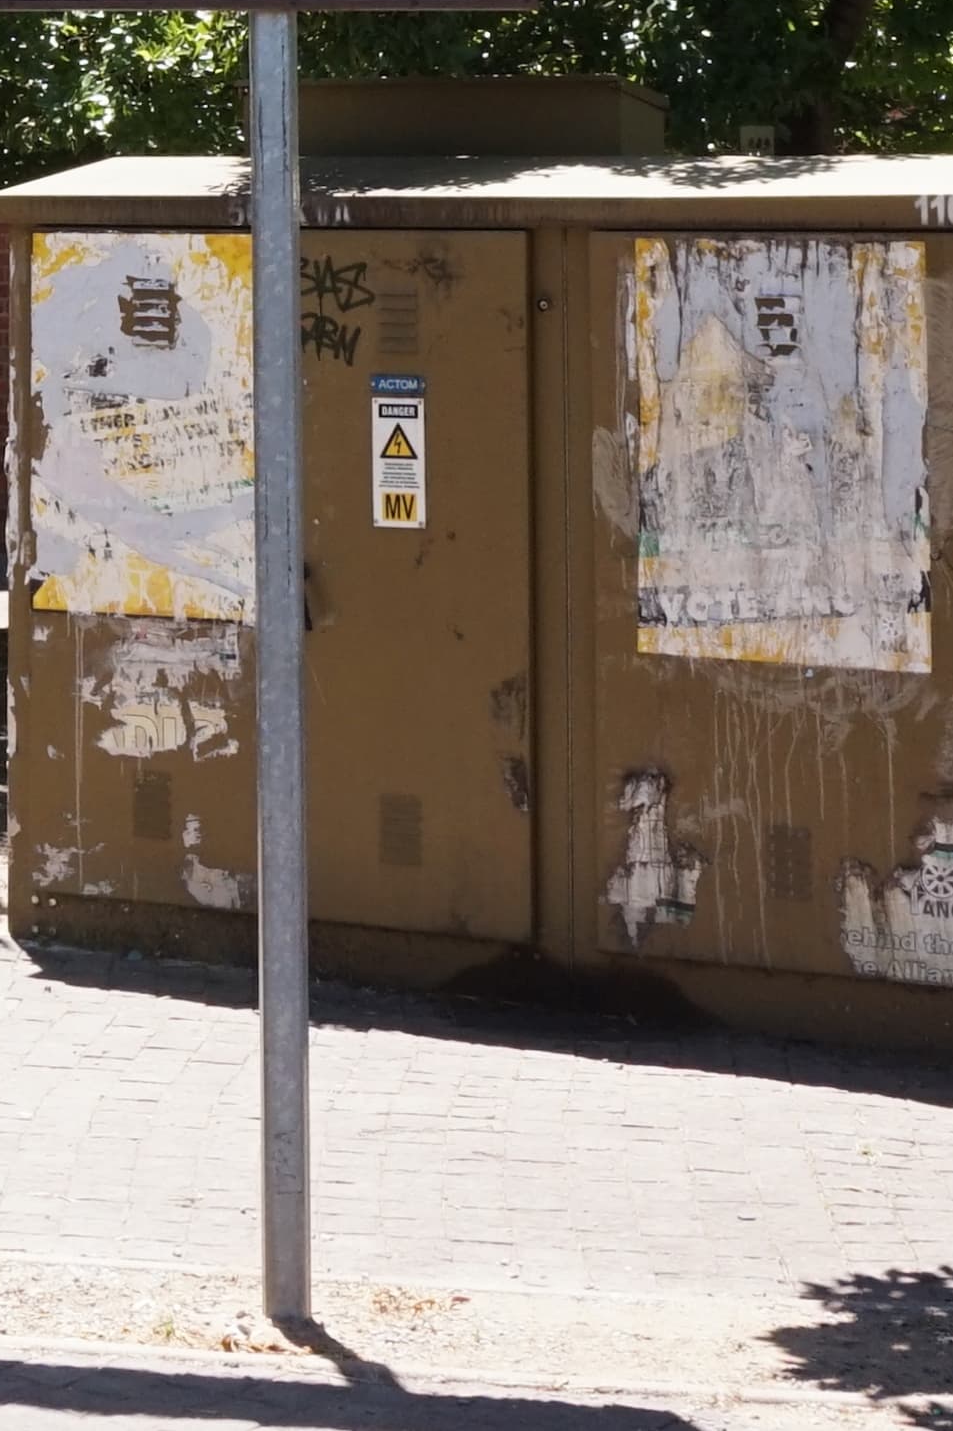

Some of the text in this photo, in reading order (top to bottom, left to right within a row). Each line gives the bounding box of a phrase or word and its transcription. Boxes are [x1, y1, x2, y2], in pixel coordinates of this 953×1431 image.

[378, 379, 418, 390] ACTOM
[381, 405, 416, 417] DANGER
[385, 494, 415, 519] MV
[922, 900, 953, 919] AN
[923, 932, 953, 955] th
